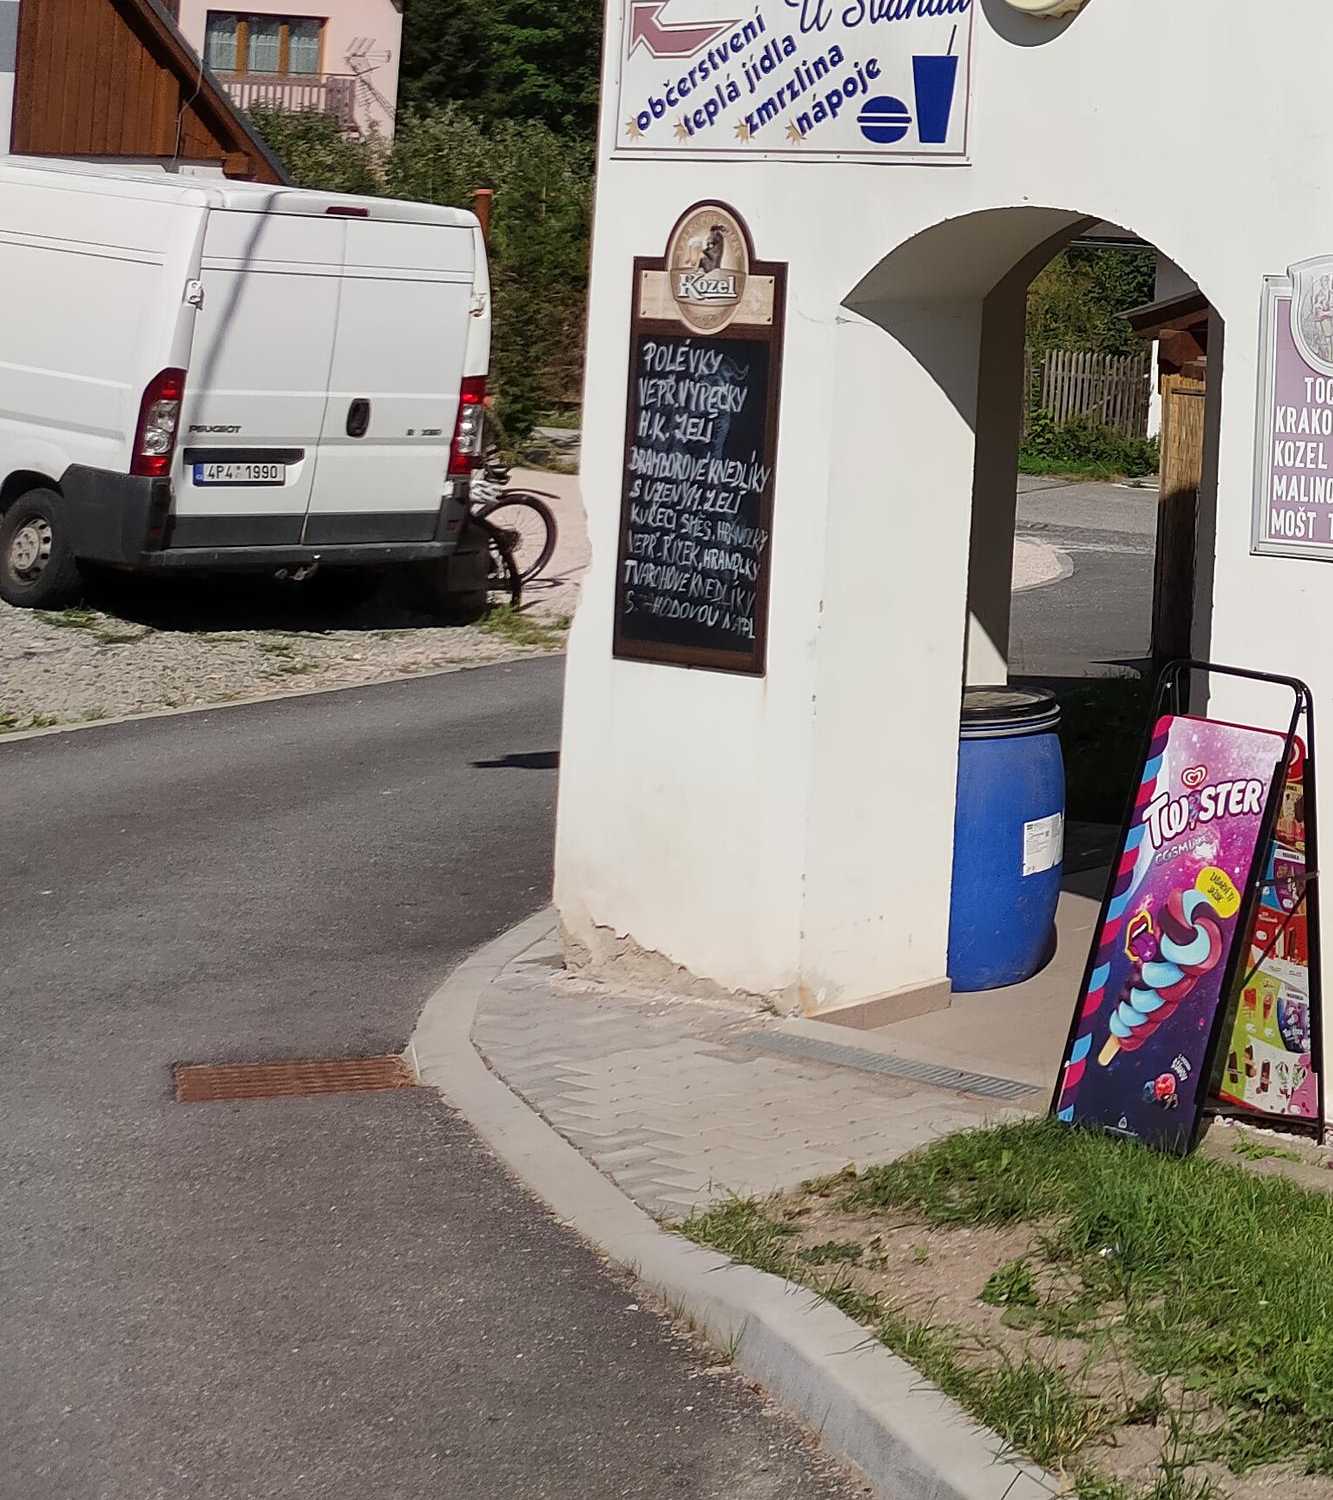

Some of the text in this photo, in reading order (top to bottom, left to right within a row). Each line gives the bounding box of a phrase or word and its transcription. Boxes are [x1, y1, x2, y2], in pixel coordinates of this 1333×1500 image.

[636, 5, 766, 131] občerstvení
[683, 33, 797, 136] teplá jídla
[744, 44, 845, 135] zmrzlina
[796, 57, 882, 136] nápoje
[677, 273, 737, 300] Kozel
[643, 339, 723, 377] POLÉVKY
[207, 465, 278, 480] 4P4 1990
[1274, 440, 1328, 470] KOZEL
[629, 479, 642, 497] S
[1271, 506, 1317, 539] MOŠT
